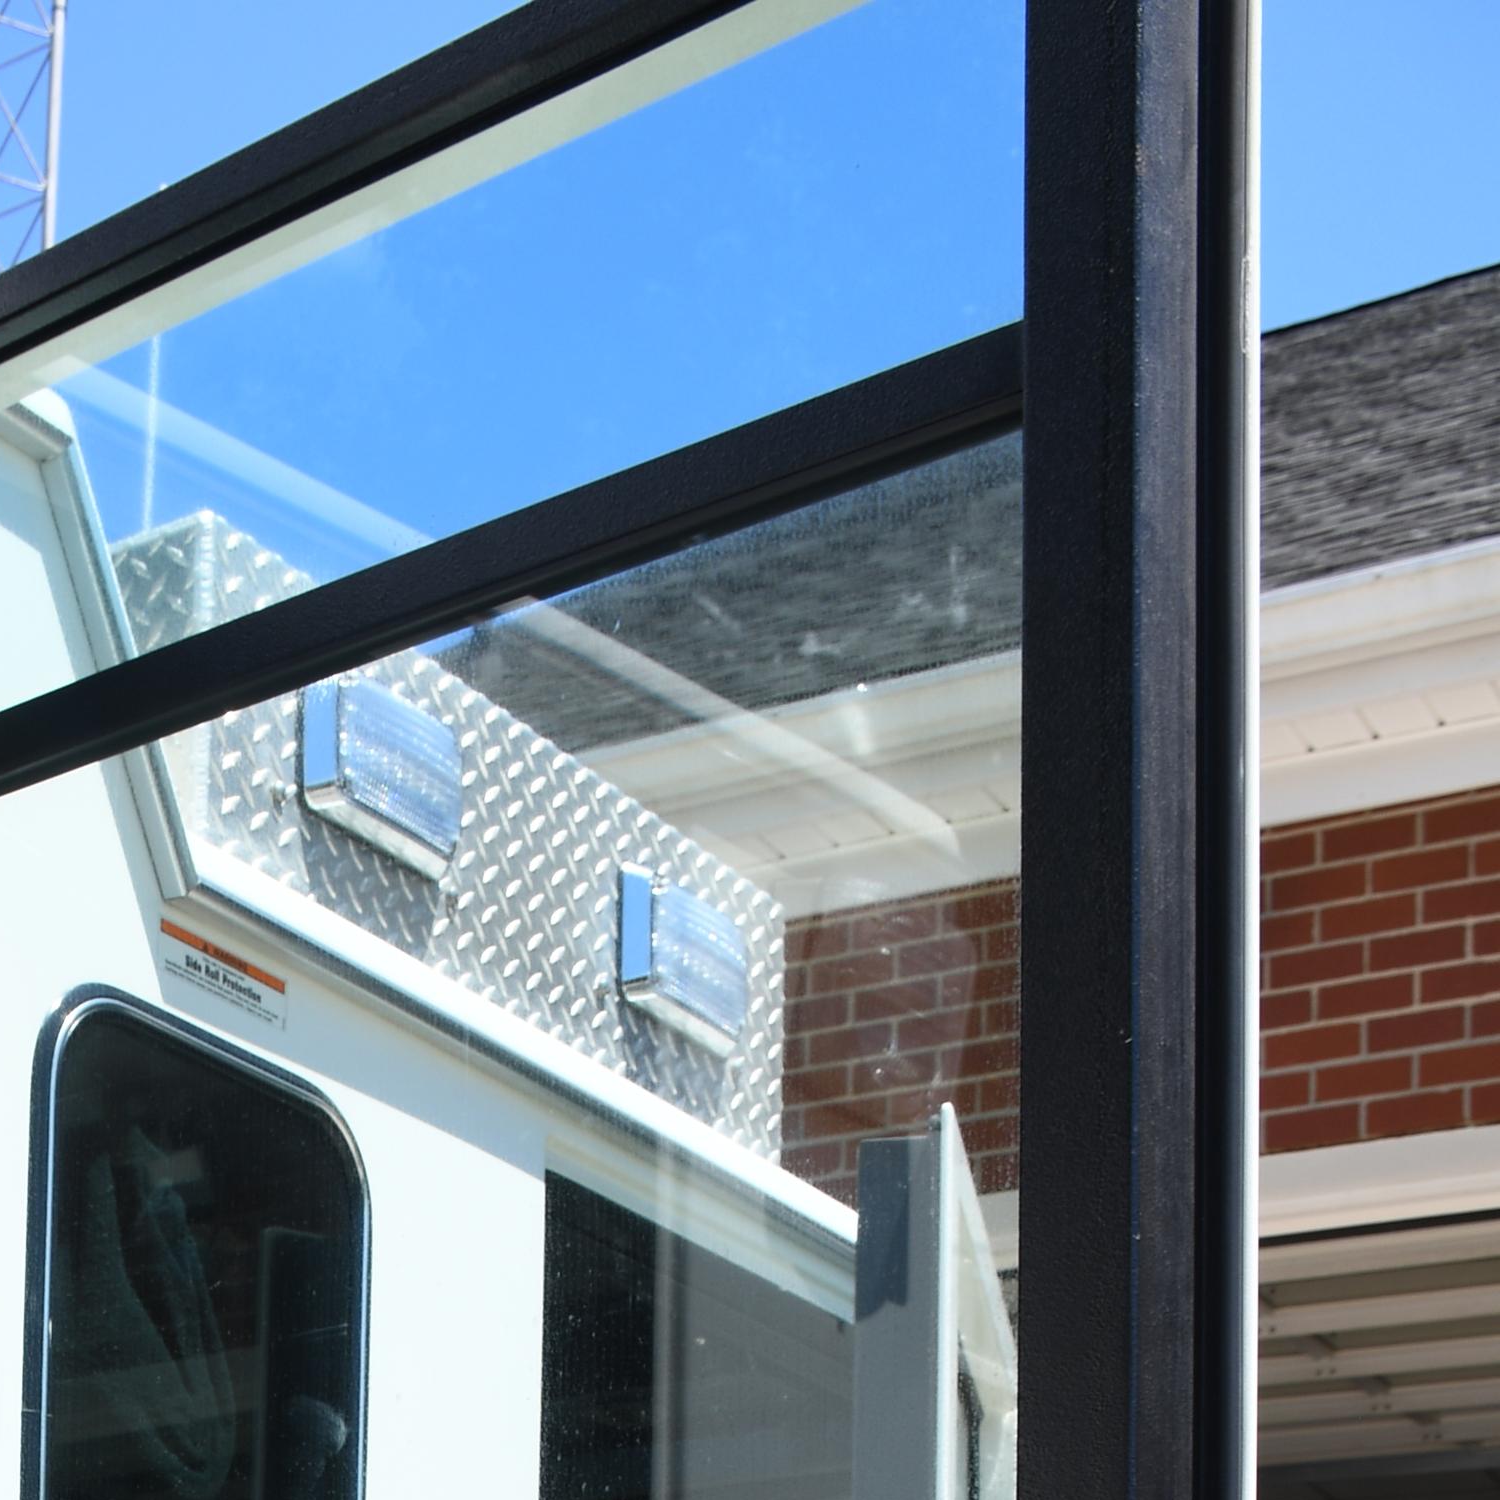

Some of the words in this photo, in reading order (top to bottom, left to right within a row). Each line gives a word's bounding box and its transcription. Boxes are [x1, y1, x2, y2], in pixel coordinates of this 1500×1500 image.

[185, 954, 202, 973] Side
[205, 964, 220, 981] Roll
[223, 973, 261, 1003] Protection
